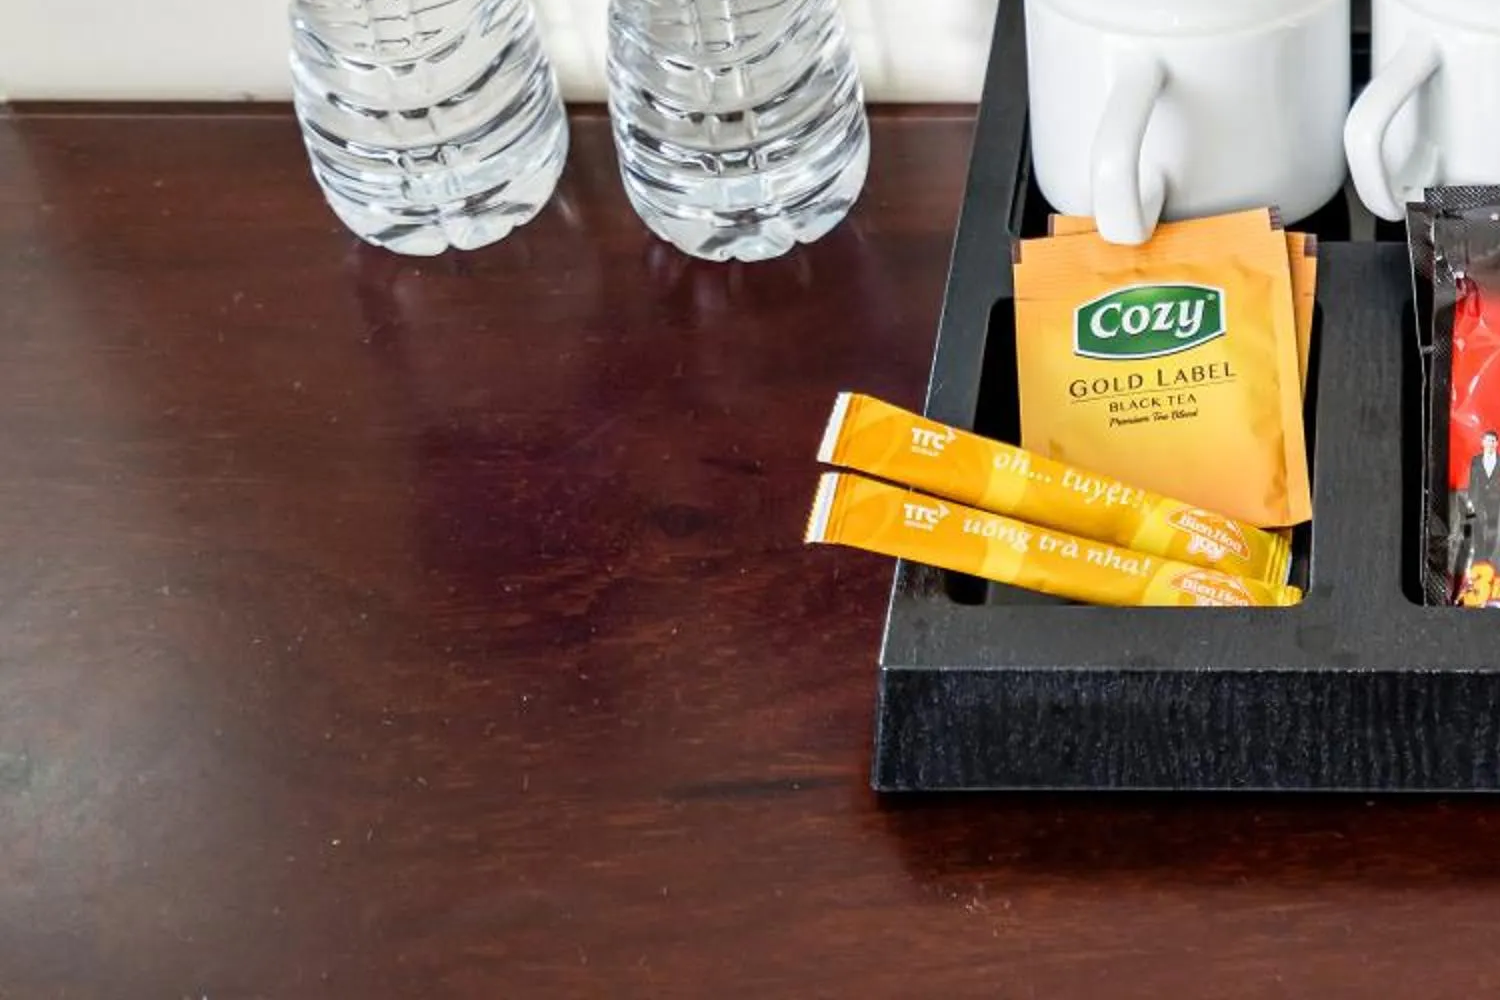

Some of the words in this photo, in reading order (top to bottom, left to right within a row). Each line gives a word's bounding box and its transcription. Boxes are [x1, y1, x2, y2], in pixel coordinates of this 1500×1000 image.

[1089, 299, 1205, 339] Cozy
[1069, 372, 1144, 399] GOLD
[1156, 361, 1238, 388] LABEL
[1109, 397, 1161, 413] BLACK
[1168, 393, 1198, 407] TEA
[1038, 534, 1080, 560] trà
[1086, 549, 1151, 577] nha!
